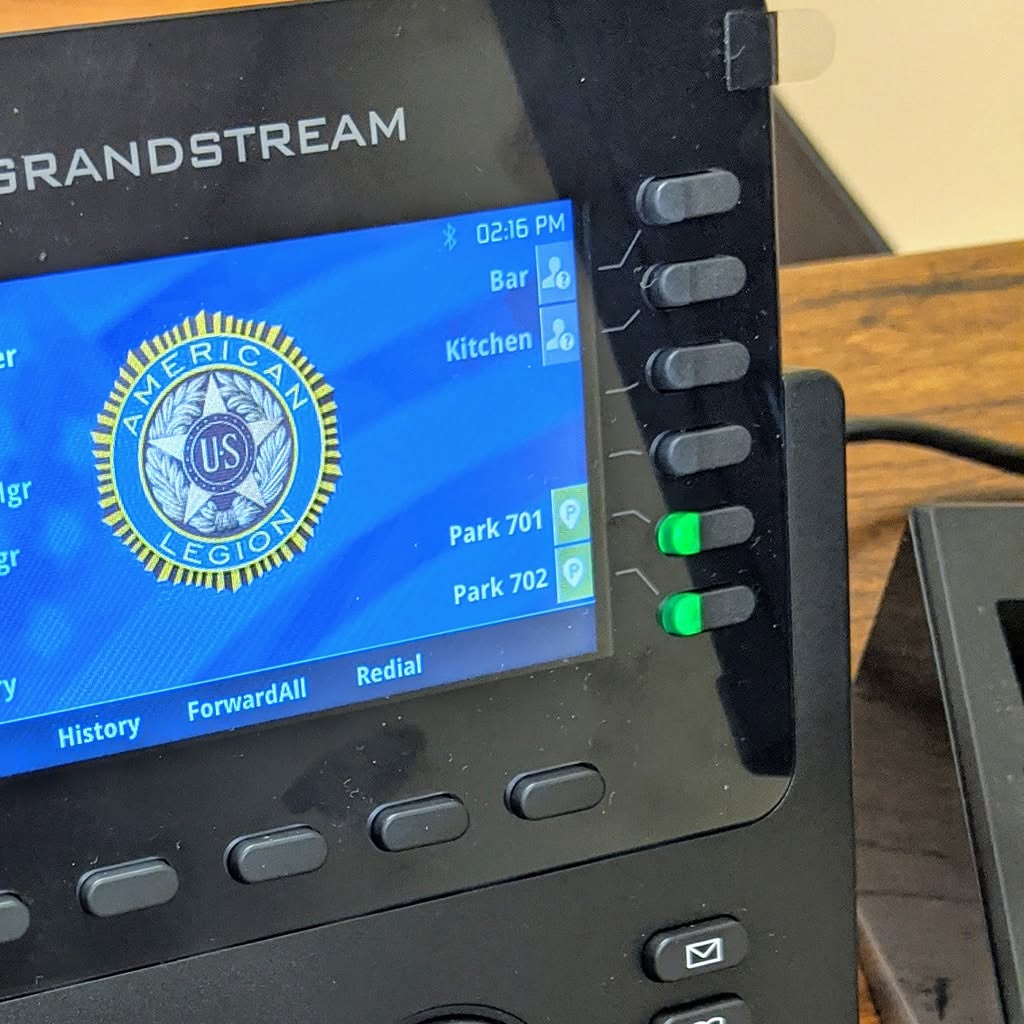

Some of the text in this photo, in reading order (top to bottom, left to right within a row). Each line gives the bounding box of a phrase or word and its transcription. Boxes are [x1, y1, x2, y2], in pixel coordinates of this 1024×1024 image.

[476, 213, 565, 244] 02:16 PM
[490, 268, 529, 292] Bar
[446, 331, 533, 362] Kitchen
[123, 339, 308, 436] AMERICAN
[159, 509, 295, 565] LEGION
[449, 509, 542, 547] Park 701
[454, 568, 549, 605] Park 702
[356, 653, 422, 687] Redial
[187, 677, 307, 722] ForwardAll
[58, 714, 141, 749] History
